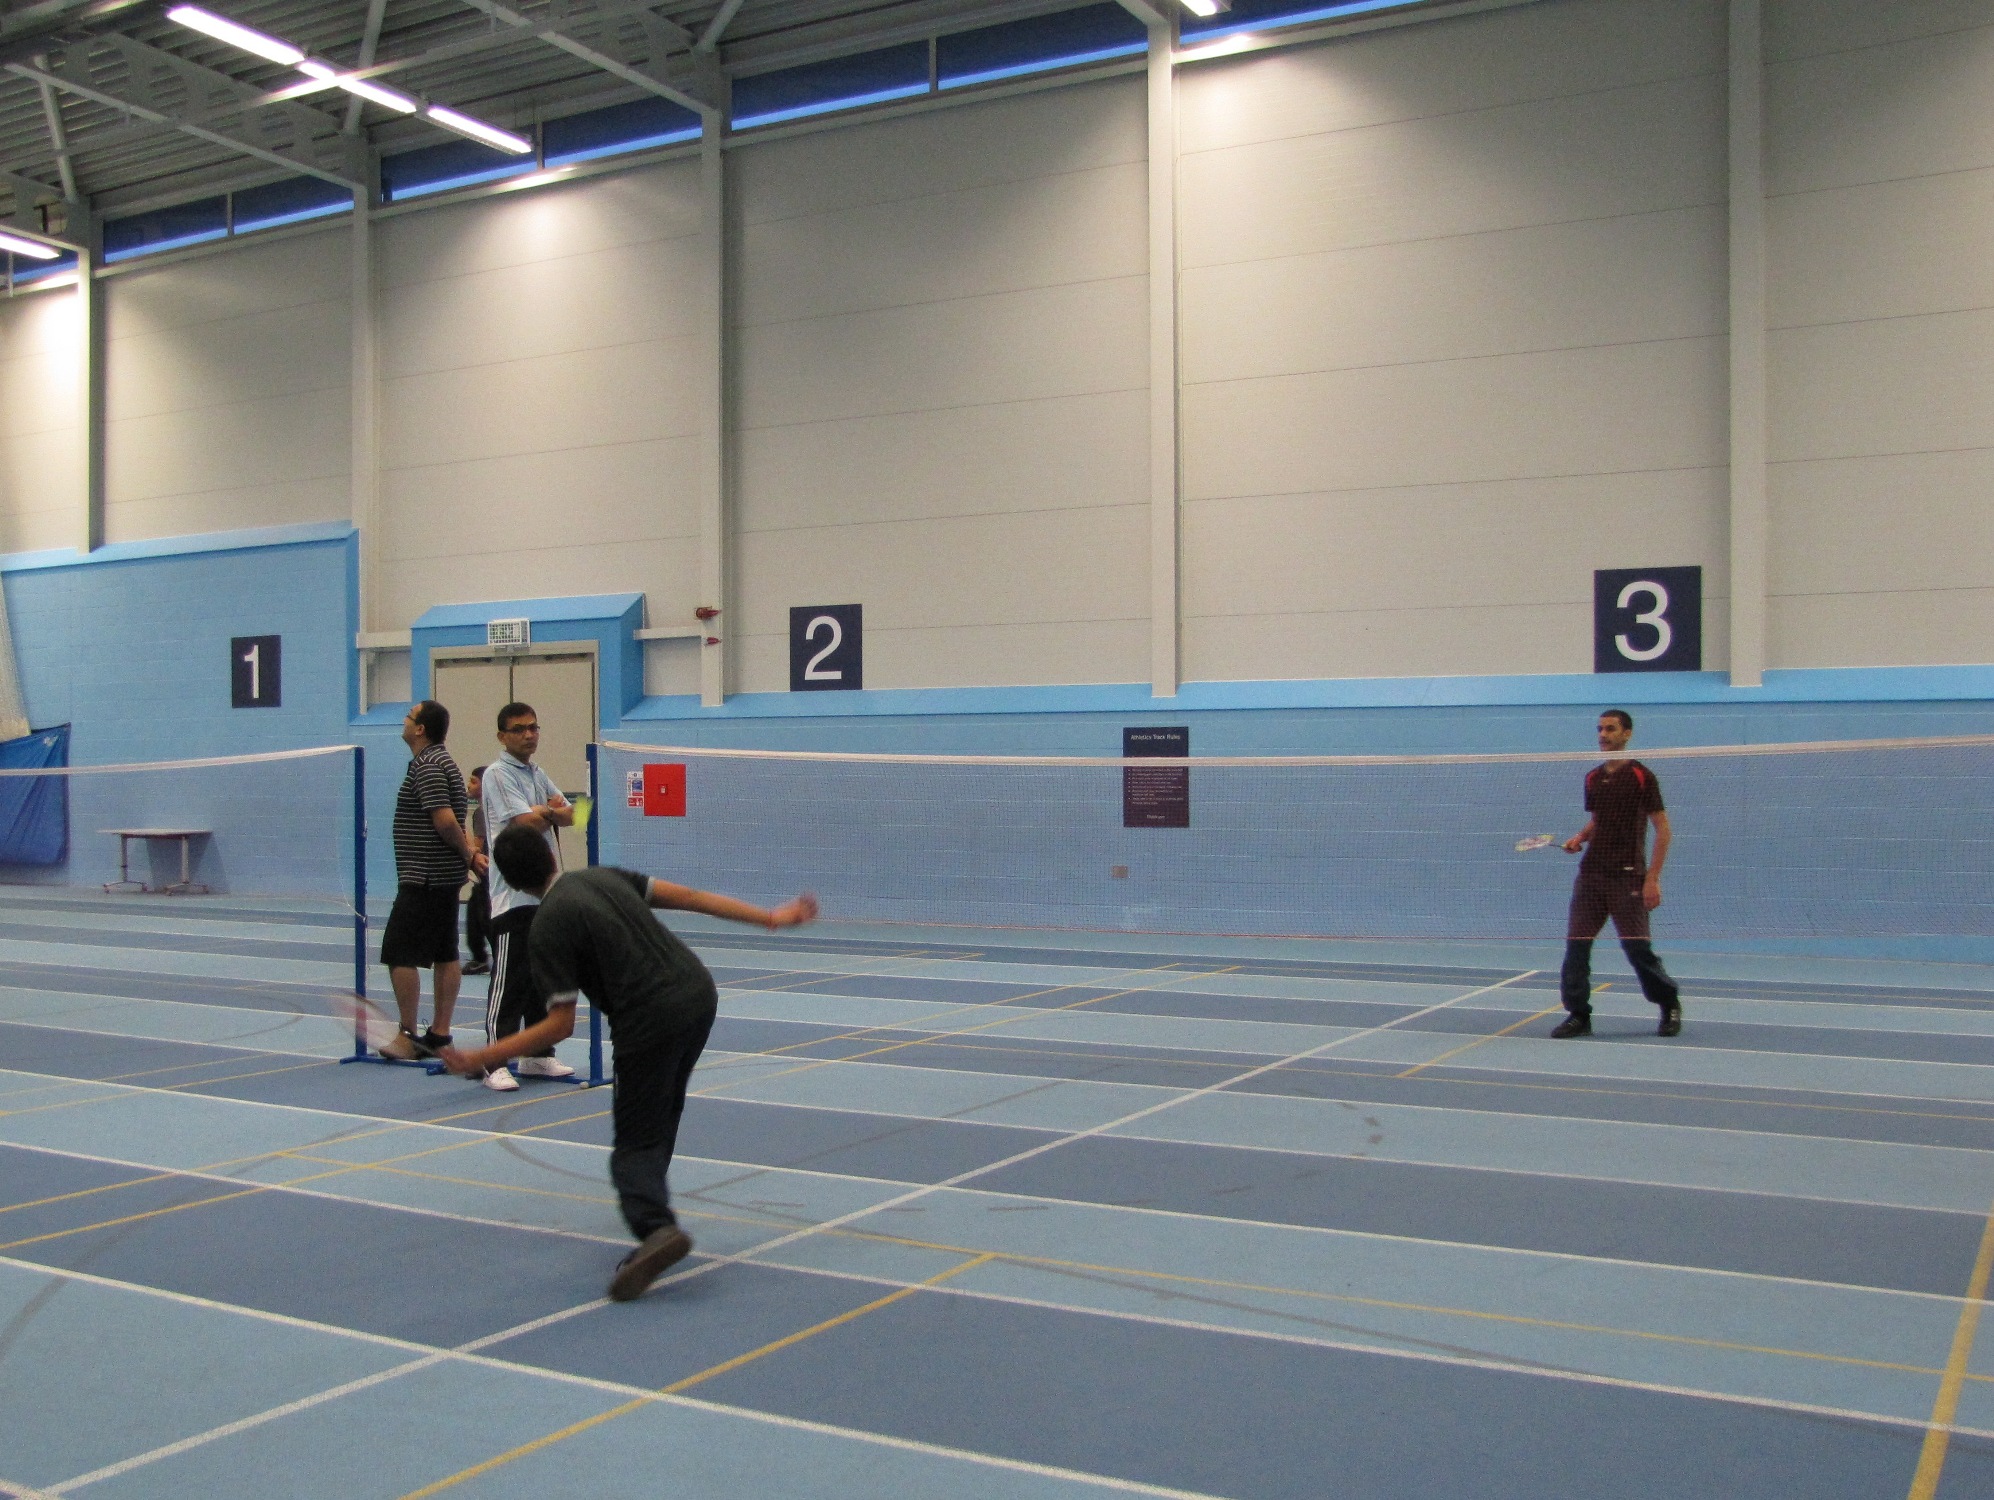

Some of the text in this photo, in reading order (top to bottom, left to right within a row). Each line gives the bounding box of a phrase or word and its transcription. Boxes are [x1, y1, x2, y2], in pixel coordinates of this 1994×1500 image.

[804, 616, 842, 681] 2
[1614, 580, 1671, 661] 3
[244, 644, 259, 699] 1
